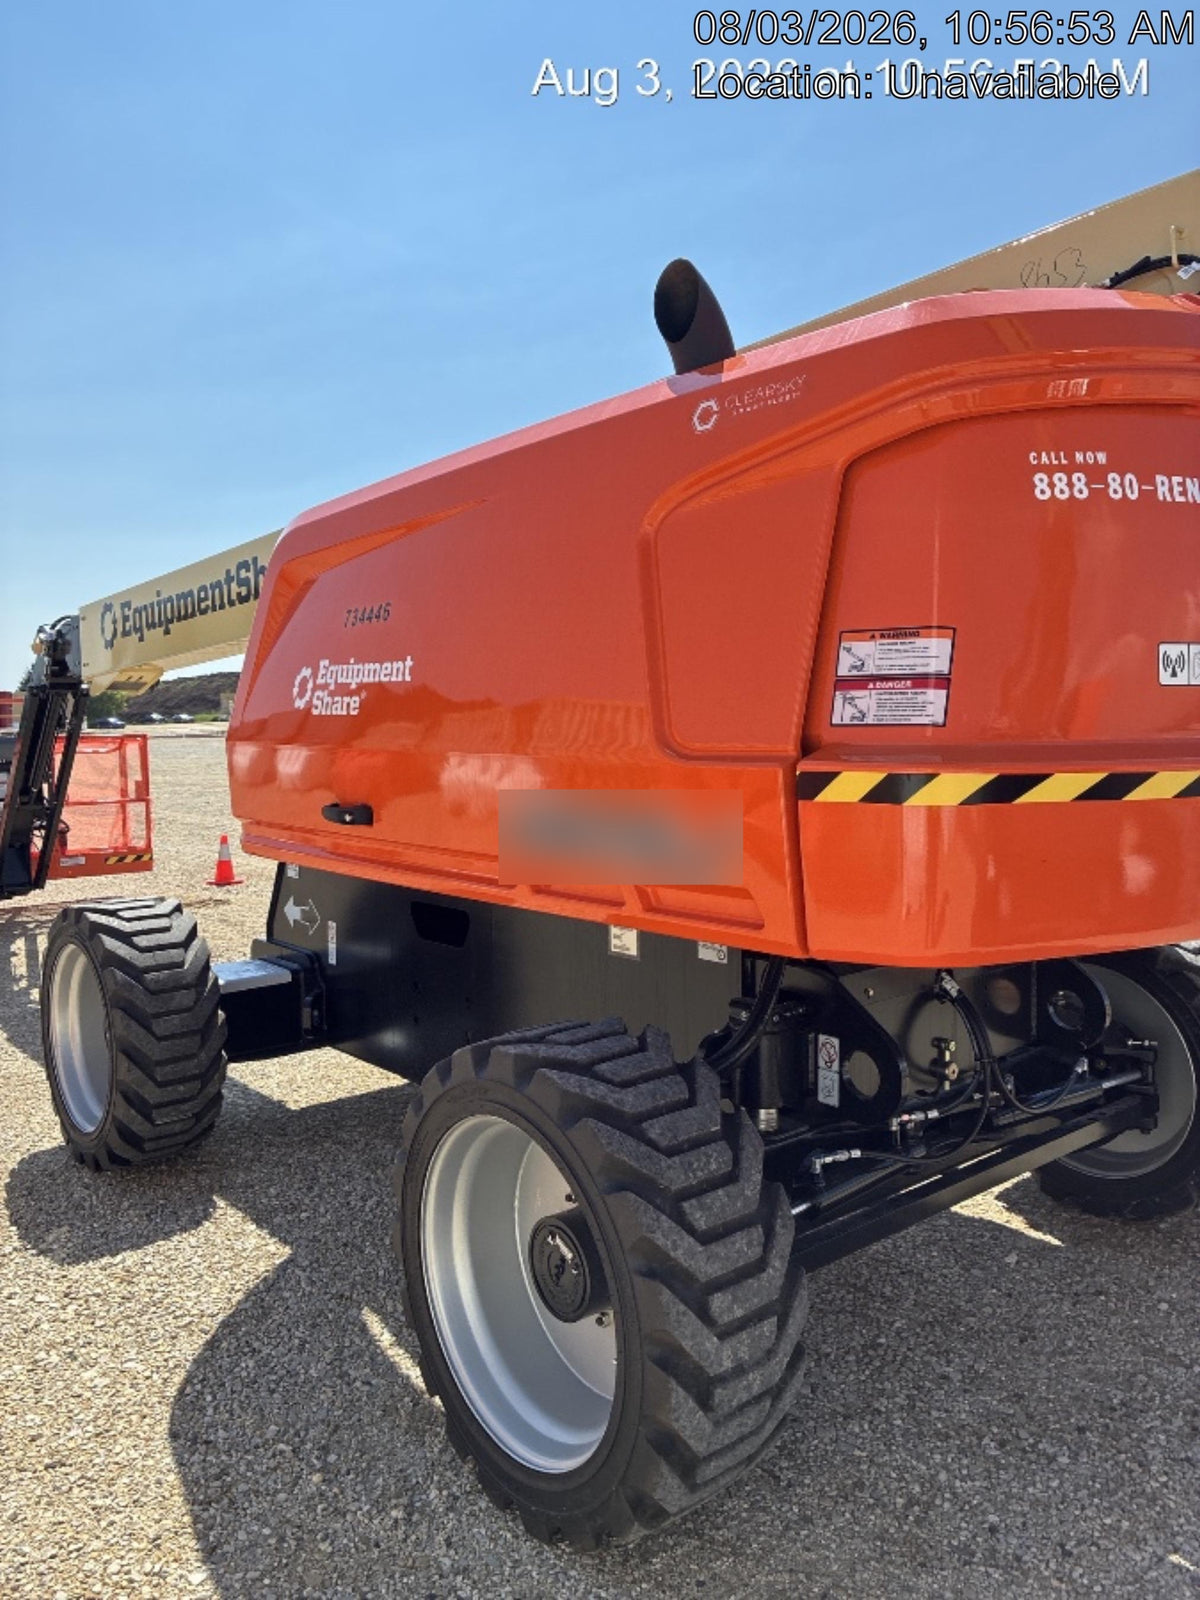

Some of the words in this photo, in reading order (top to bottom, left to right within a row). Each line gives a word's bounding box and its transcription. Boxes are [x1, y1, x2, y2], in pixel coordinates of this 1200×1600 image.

[1029, 451, 1068, 465] CALL
[1075, 451, 1107, 465] NOW
[315, 655, 414, 690] Equipment
